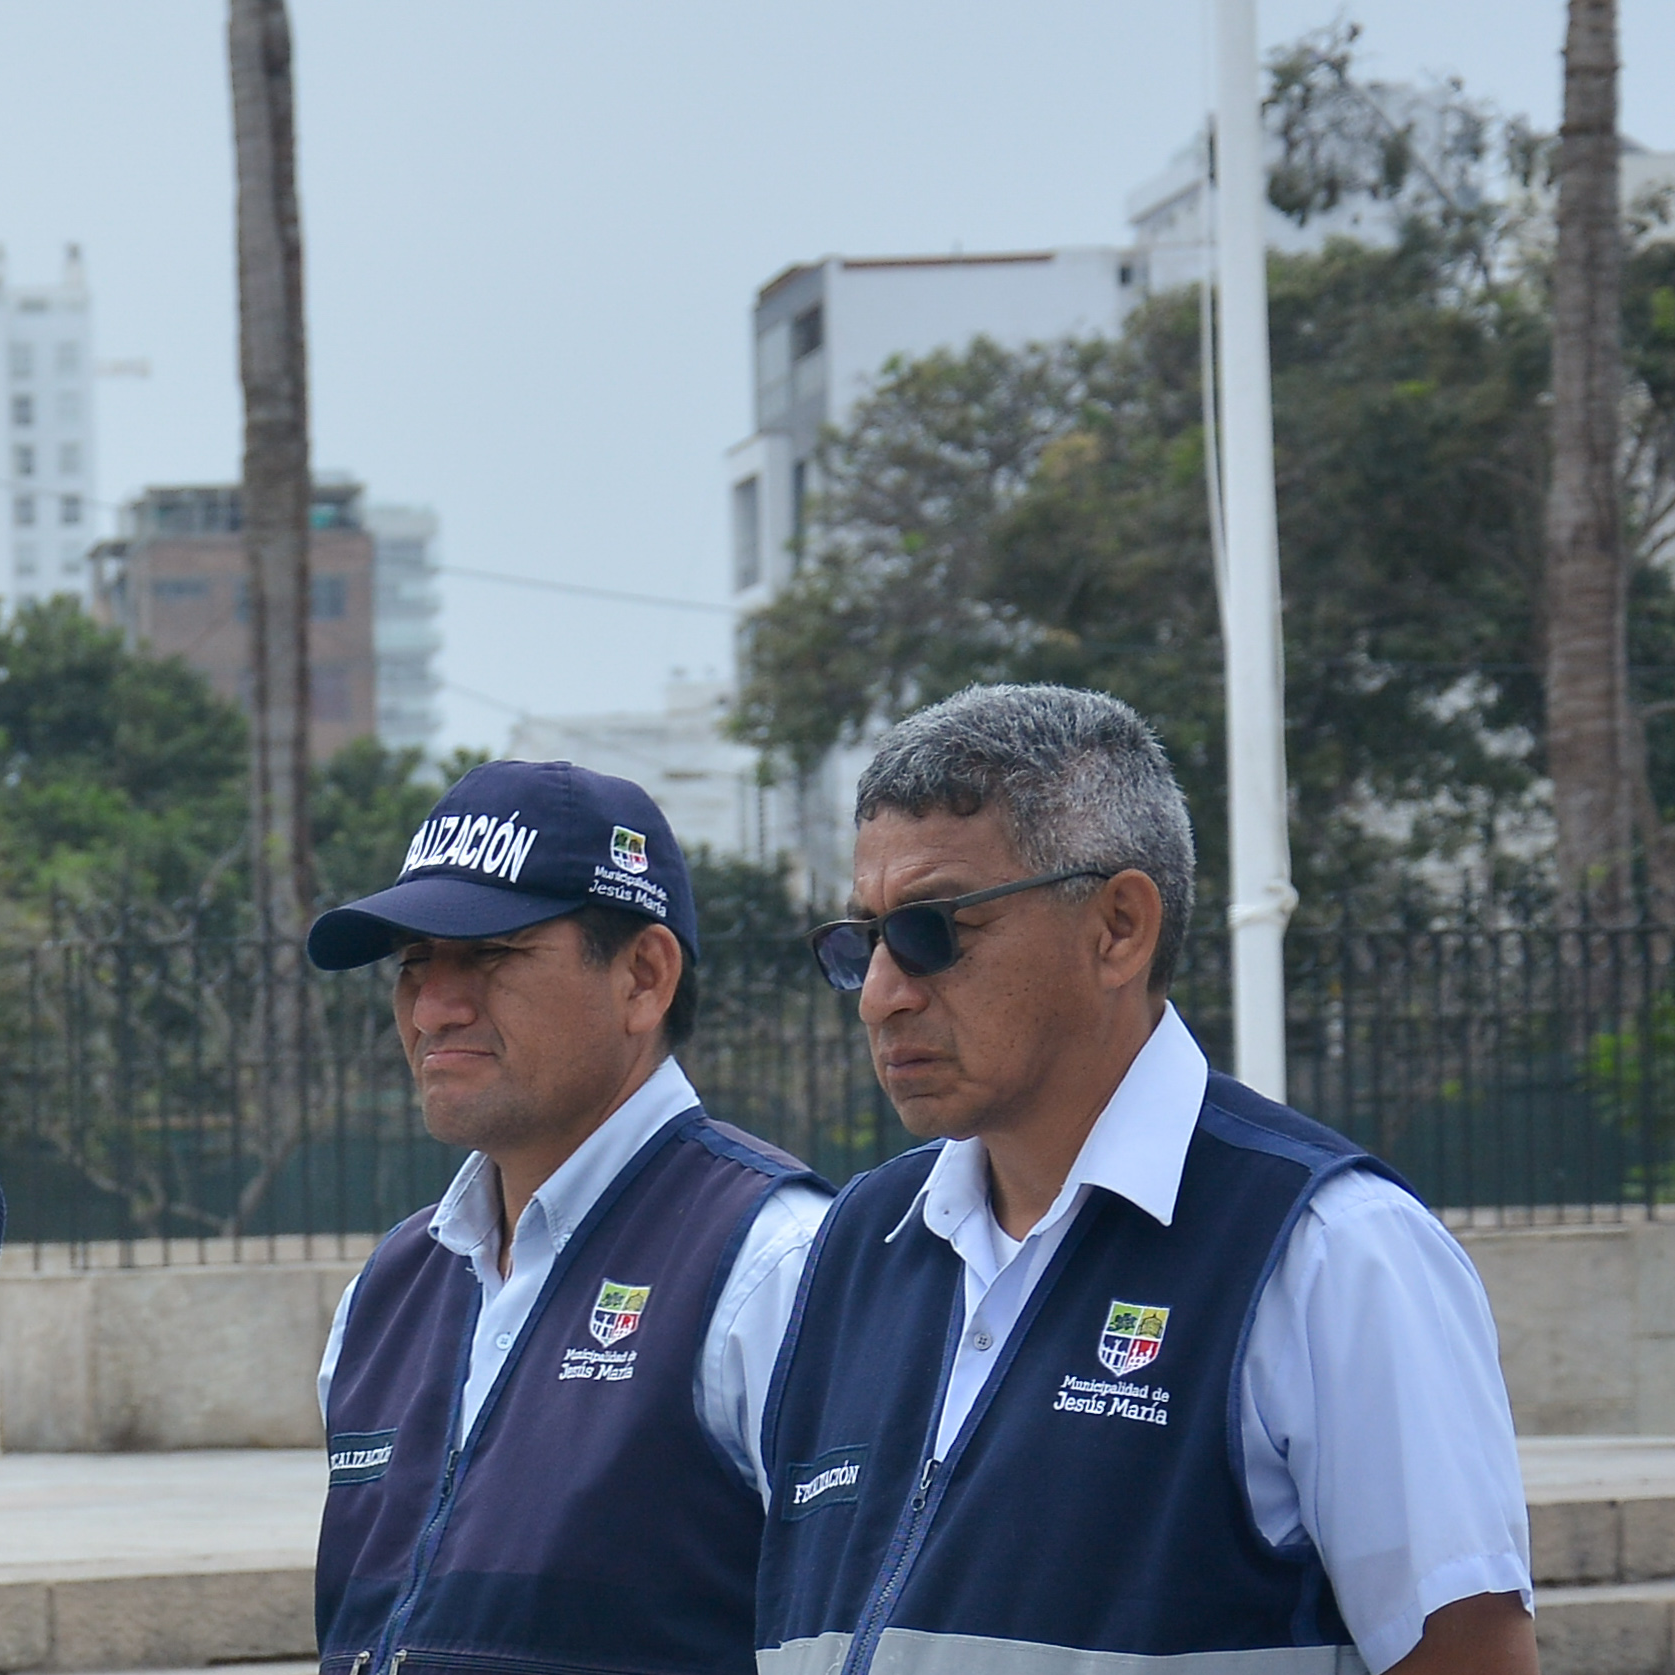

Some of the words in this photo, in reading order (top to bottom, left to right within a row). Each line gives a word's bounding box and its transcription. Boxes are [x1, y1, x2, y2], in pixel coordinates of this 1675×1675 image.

[588, 879, 632, 901] Jesús
[1061, 1375, 1149, 1398] Municipalidad
[1152, 1387, 1170, 1402] de
[1053, 1391, 1106, 1415] Jesús
[1107, 1397, 1167, 1425] María
